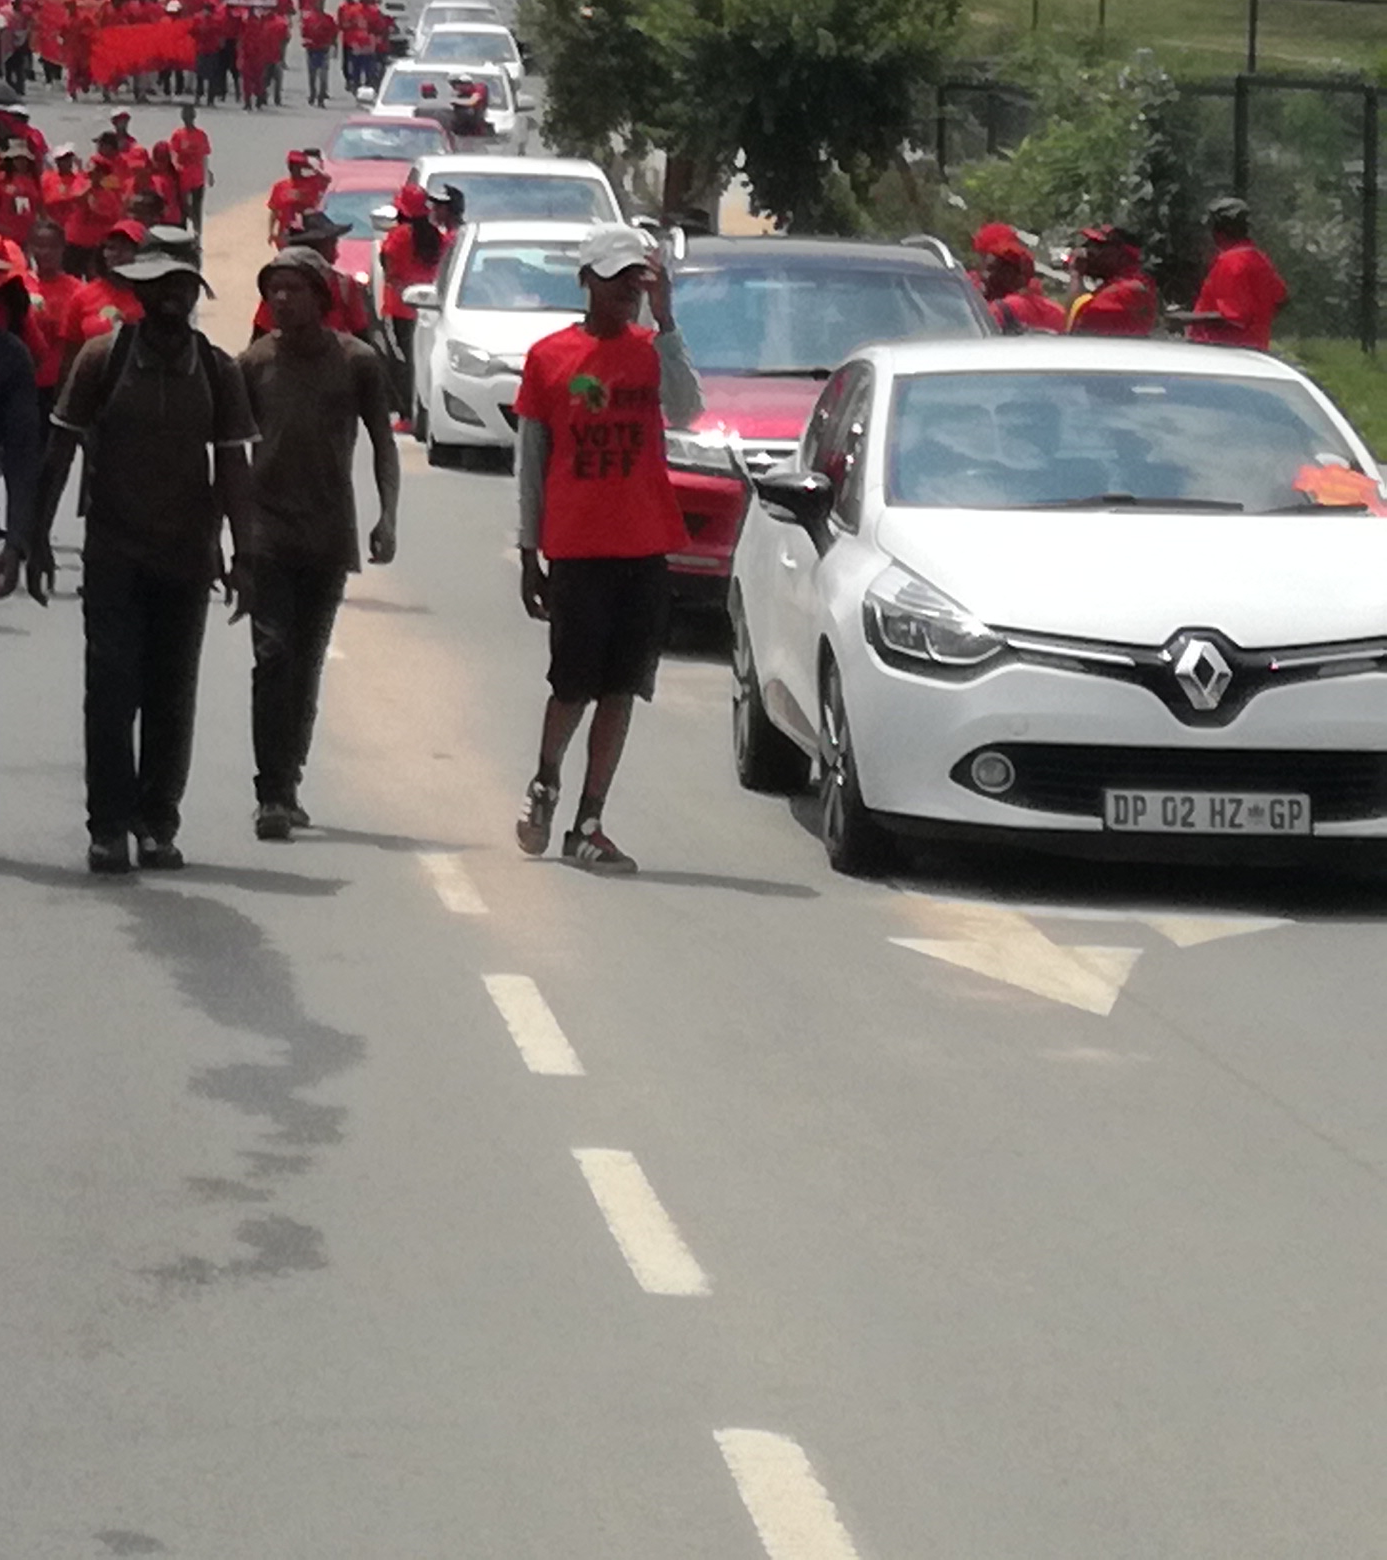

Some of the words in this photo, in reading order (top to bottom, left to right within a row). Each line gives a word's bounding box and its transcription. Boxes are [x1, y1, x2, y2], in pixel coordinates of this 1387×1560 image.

[569, 422, 644, 450] VOTE
[575, 449, 639, 480] EFF
[1113, 794, 1147, 826] DP
[1161, 795, 1196, 828] 02
[1208, 797, 1244, 829] HZ
[1269, 798, 1303, 830] GP
